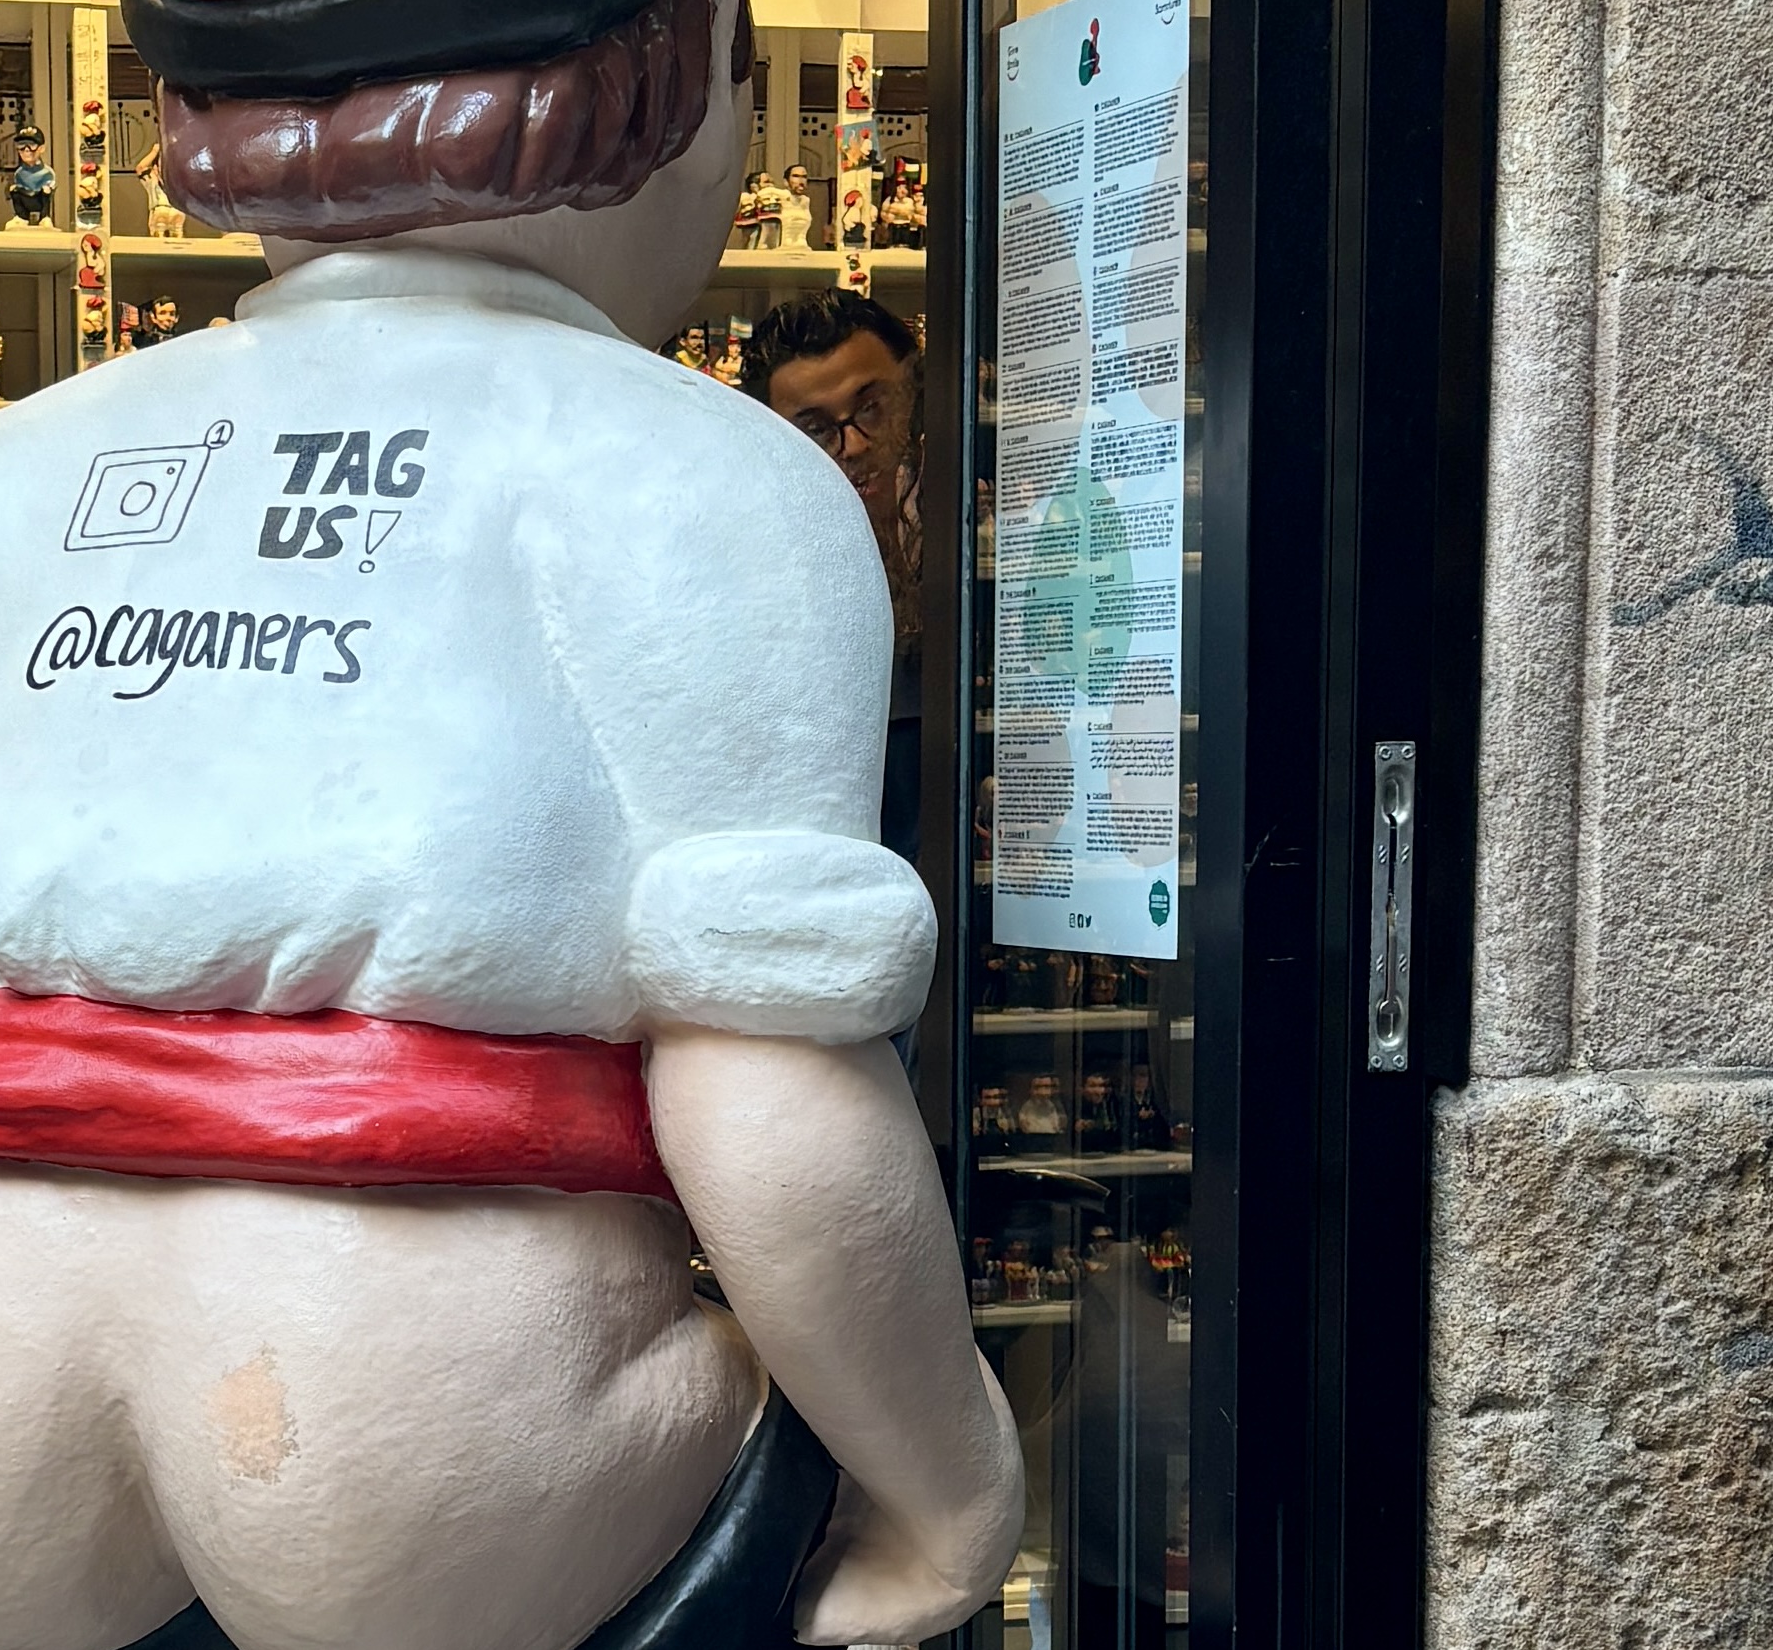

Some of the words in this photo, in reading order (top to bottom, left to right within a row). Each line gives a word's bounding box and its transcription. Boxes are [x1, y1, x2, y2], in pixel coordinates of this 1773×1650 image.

[273, 430, 430, 499] TAG
[258, 505, 402, 574] US!
[26, 605, 372, 701] @caganers
